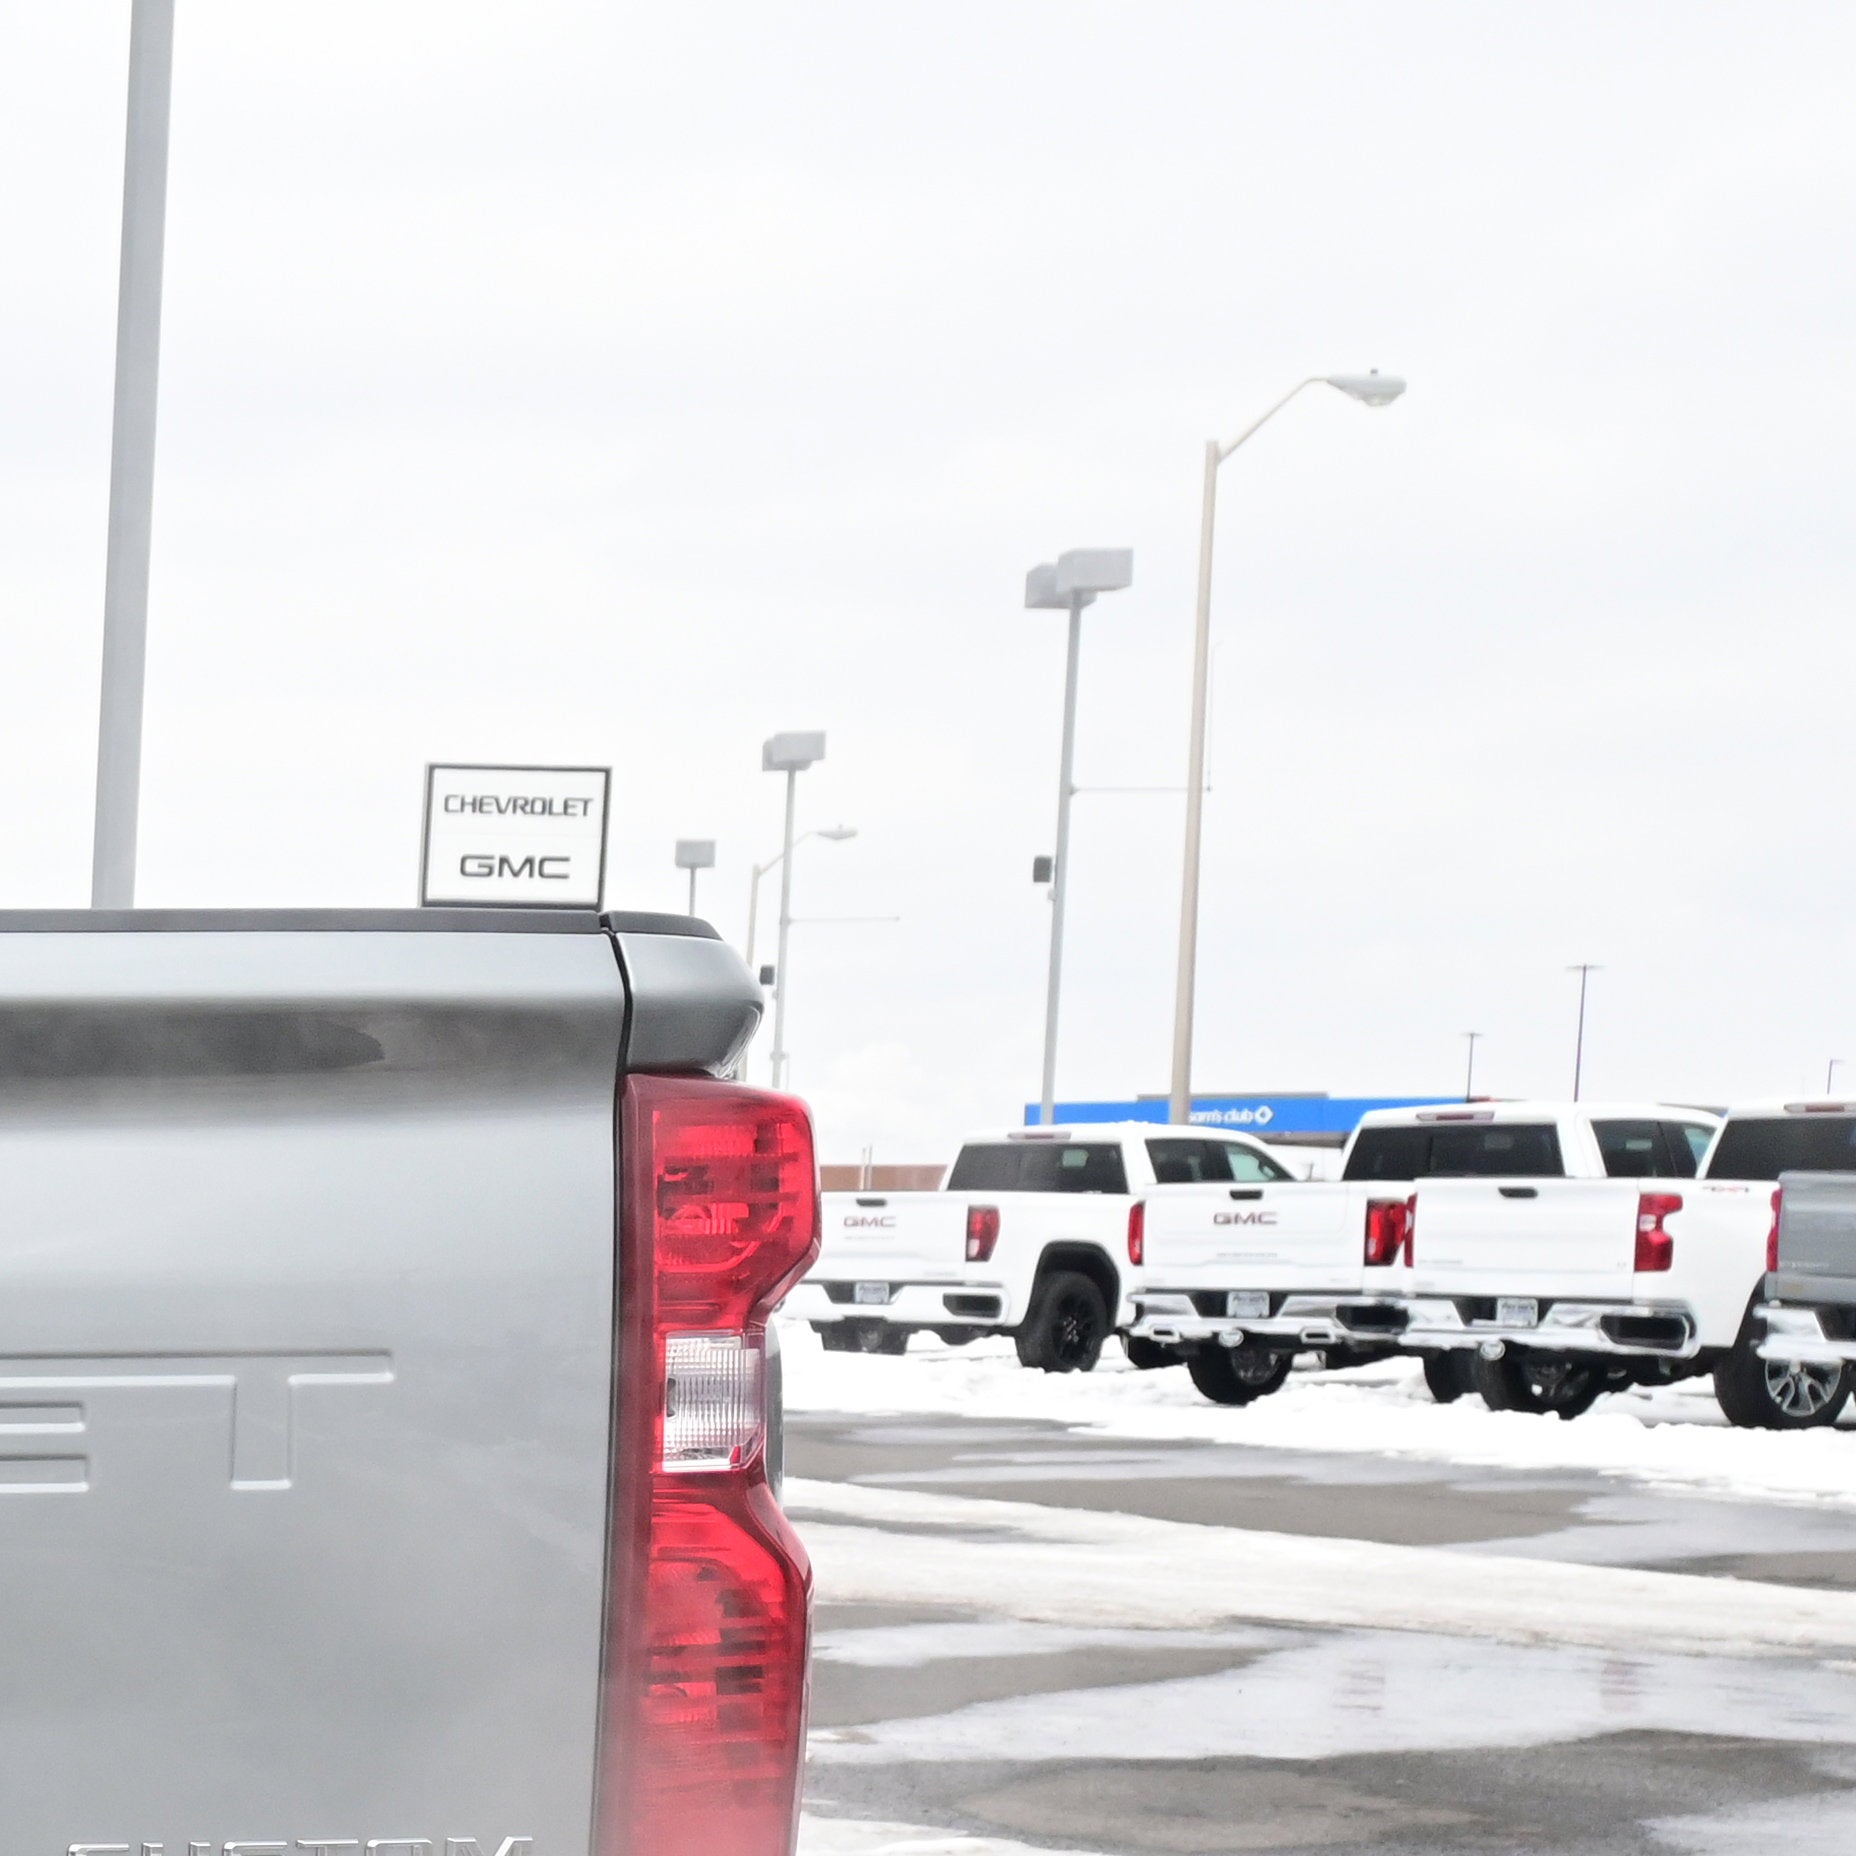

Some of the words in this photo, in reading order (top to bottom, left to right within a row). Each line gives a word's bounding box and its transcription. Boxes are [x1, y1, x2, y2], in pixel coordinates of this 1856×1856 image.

[443, 793, 594, 817] CHEVROLET
[459, 853, 571, 880] GMC
[843, 1215, 897, 1228] GMC
[1213, 1211, 1278, 1226] GMC
